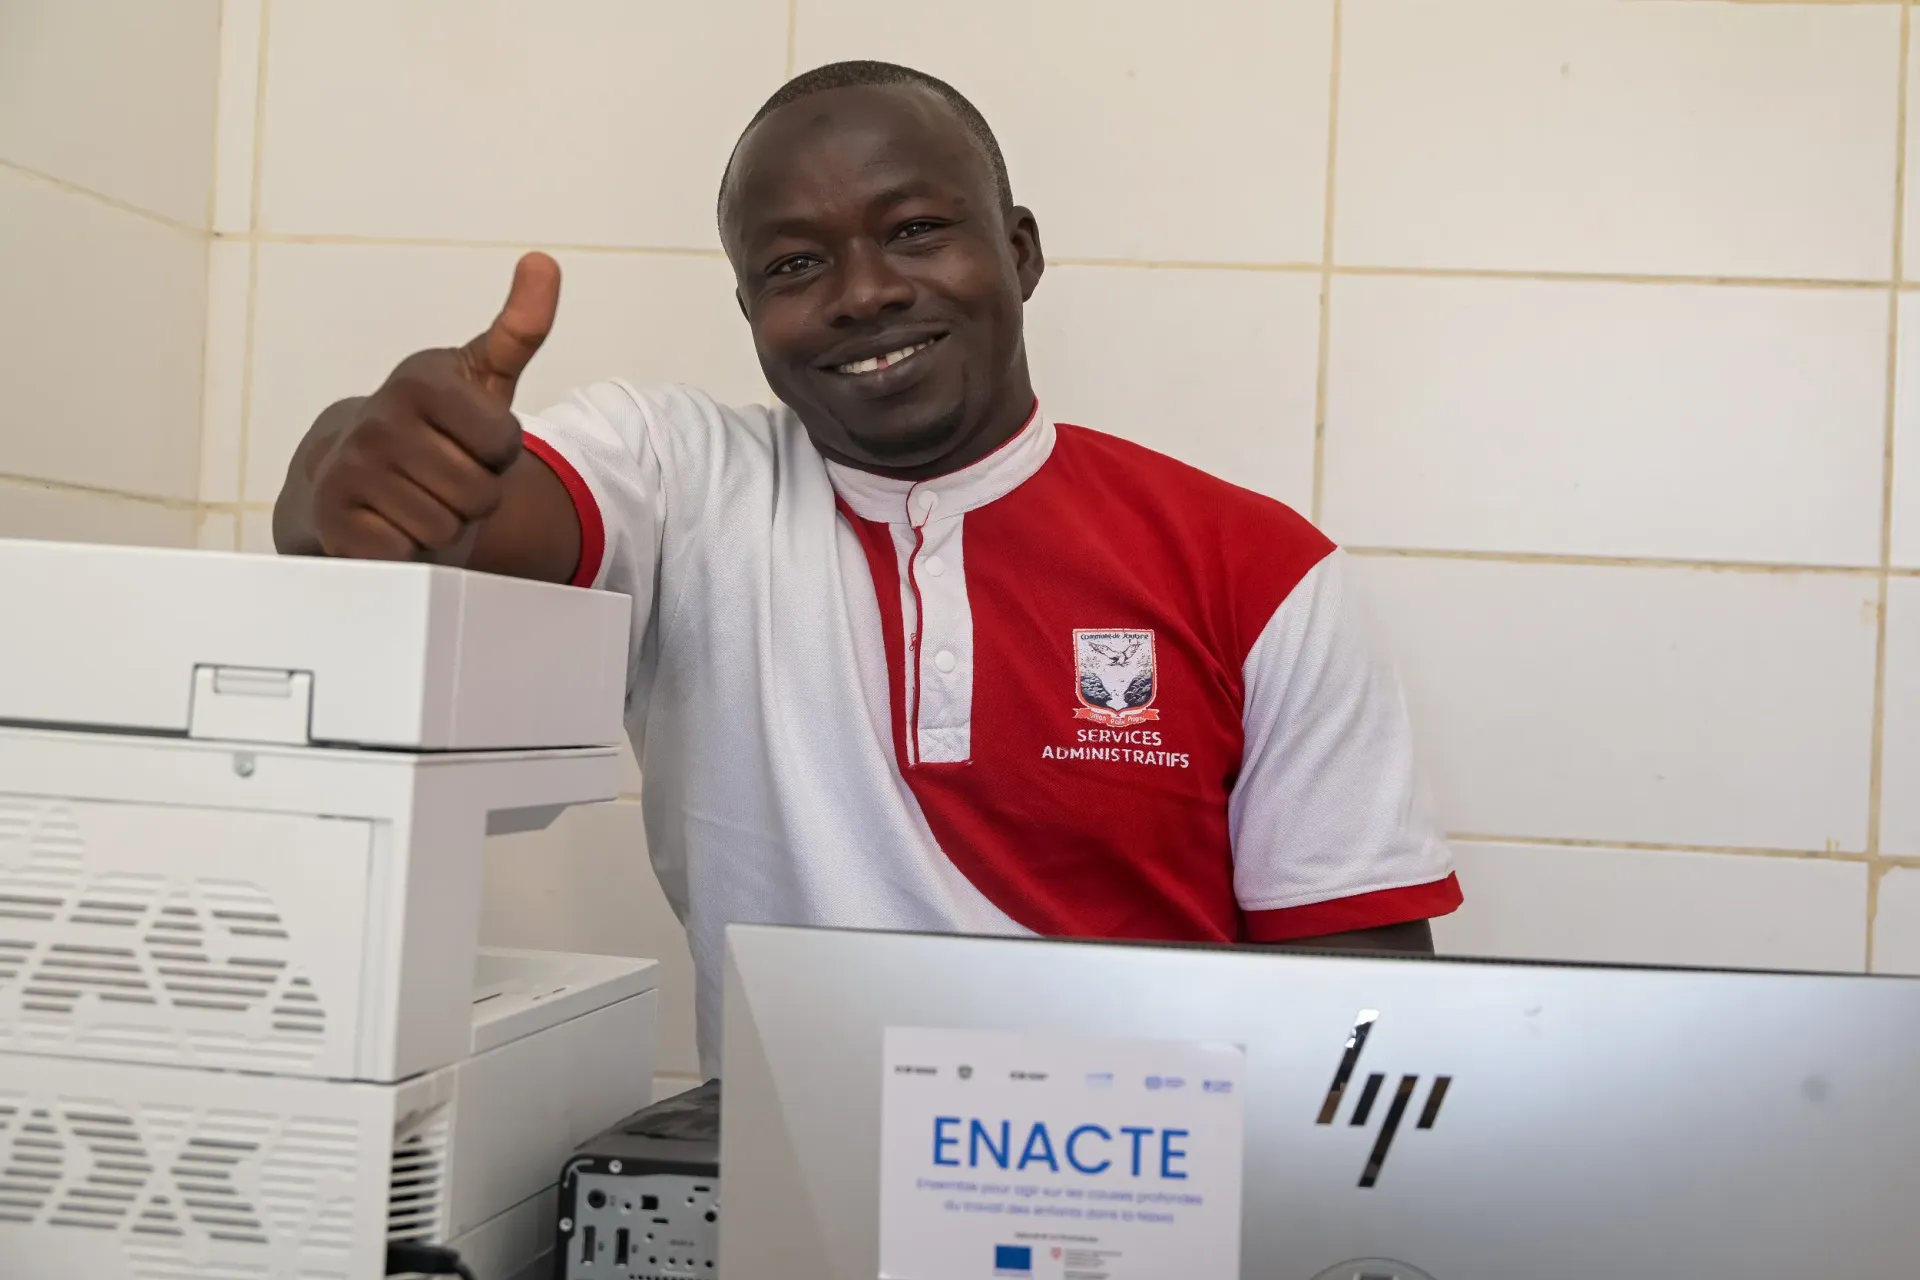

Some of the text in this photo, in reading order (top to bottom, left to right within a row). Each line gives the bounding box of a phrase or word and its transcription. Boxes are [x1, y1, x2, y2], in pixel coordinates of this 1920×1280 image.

[1077, 729, 1162, 746] SERVICES
[1041, 745, 1190, 768] ADMINISTRATIFS
[933, 1116, 1190, 1180] ENACTE
[916, 1177, 1203, 1206] Ensemble pour agir sur les causes profondes
[944, 1199, 960, 1211] du
[962, 1200, 1004, 1213] travail
[1006, 1203, 1031, 1216] des
[1033, 1204, 1082, 1218] enfants
